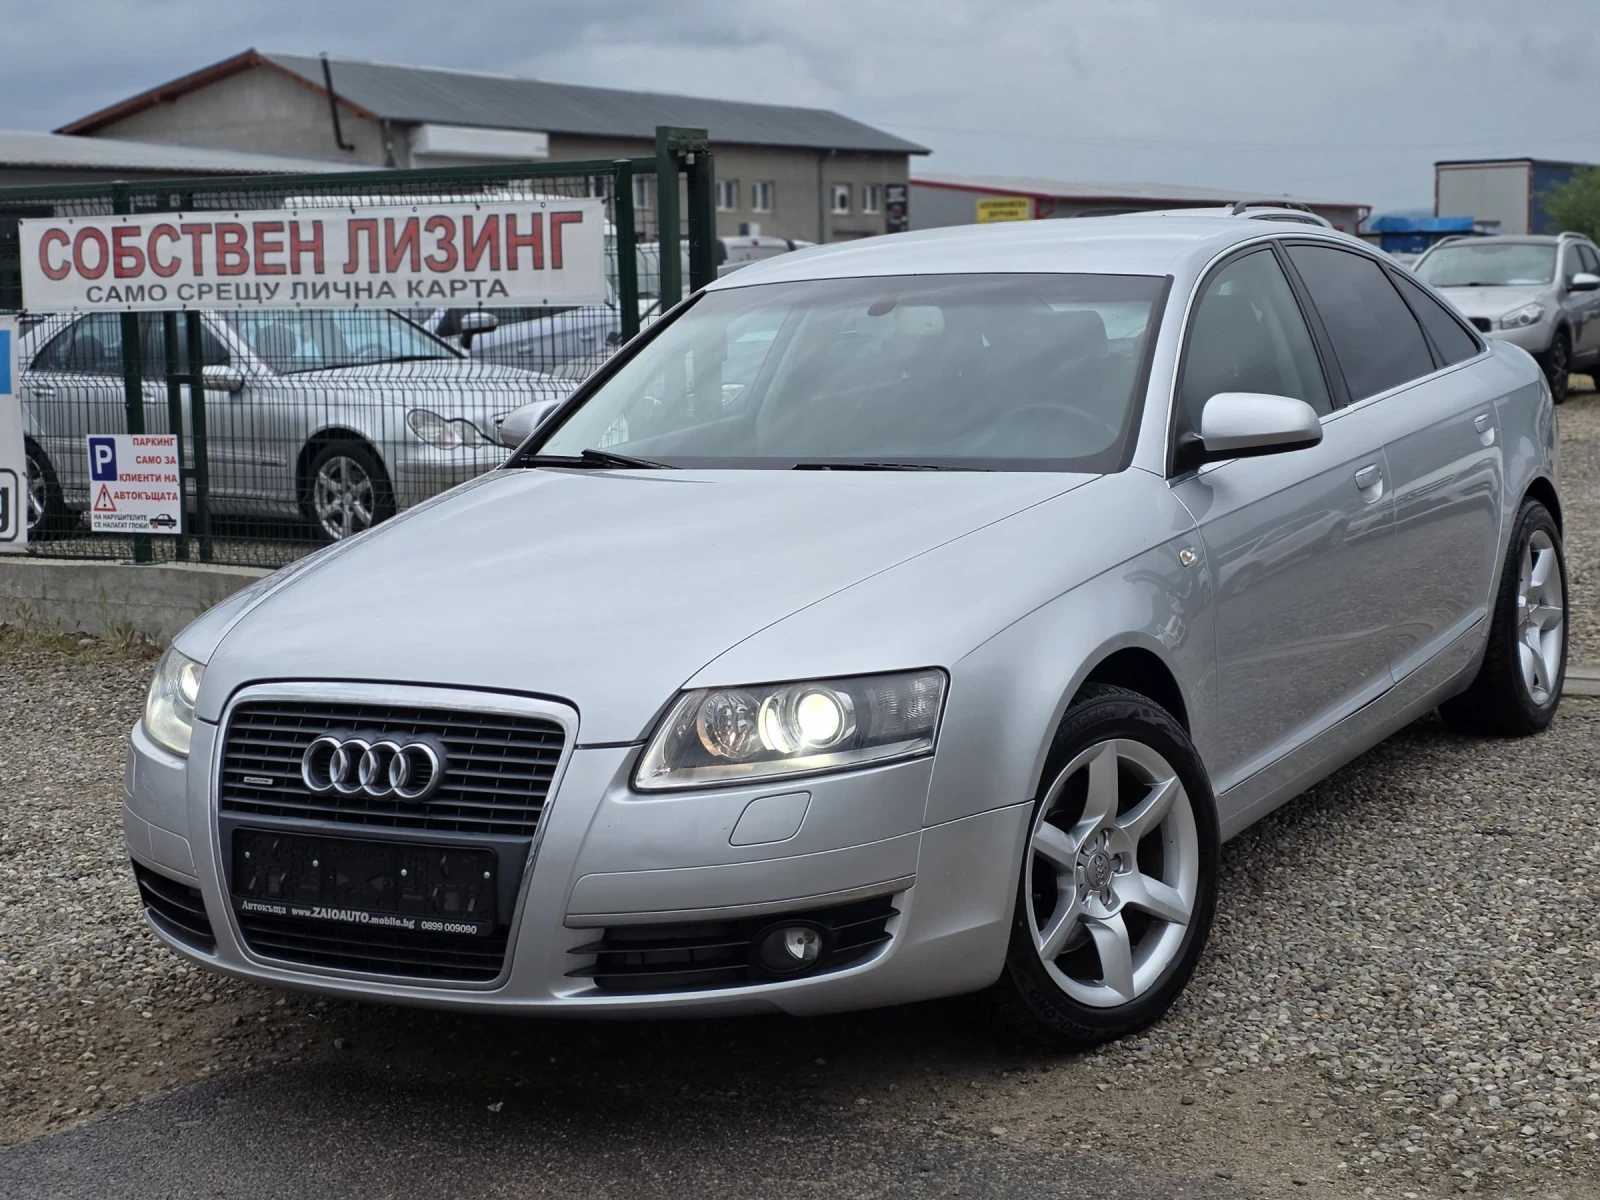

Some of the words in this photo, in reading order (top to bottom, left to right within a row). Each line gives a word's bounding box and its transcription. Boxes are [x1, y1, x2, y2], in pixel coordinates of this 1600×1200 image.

[38, 219, 325, 282] СОБСТВЕН
[342, 211, 584, 275] ЛИЗИНГ
[86, 283, 168, 303] САМО
[177, 281, 281, 304] СРЕЩУ
[290, 280, 398, 301] ЛИЧНА
[407, 278, 509, 299] КАРТА
[132, 437, 175, 447] ПАРКИНГ
[135, 456, 162, 465] САМО
[164, 456, 177, 465] ЗА
[119, 473, 161, 482] КЛИЕНТИ
[164, 474, 177, 483] НА
[114, 491, 178, 502] АВТОКЪЩАТА
[241, 900, 287, 915] Автокъща
[291, 907, 415, 930] www.ZAIOAUTO.mobile.bg
[421, 920, 443, 932] 0899
[444, 922, 477, 935] 009090
